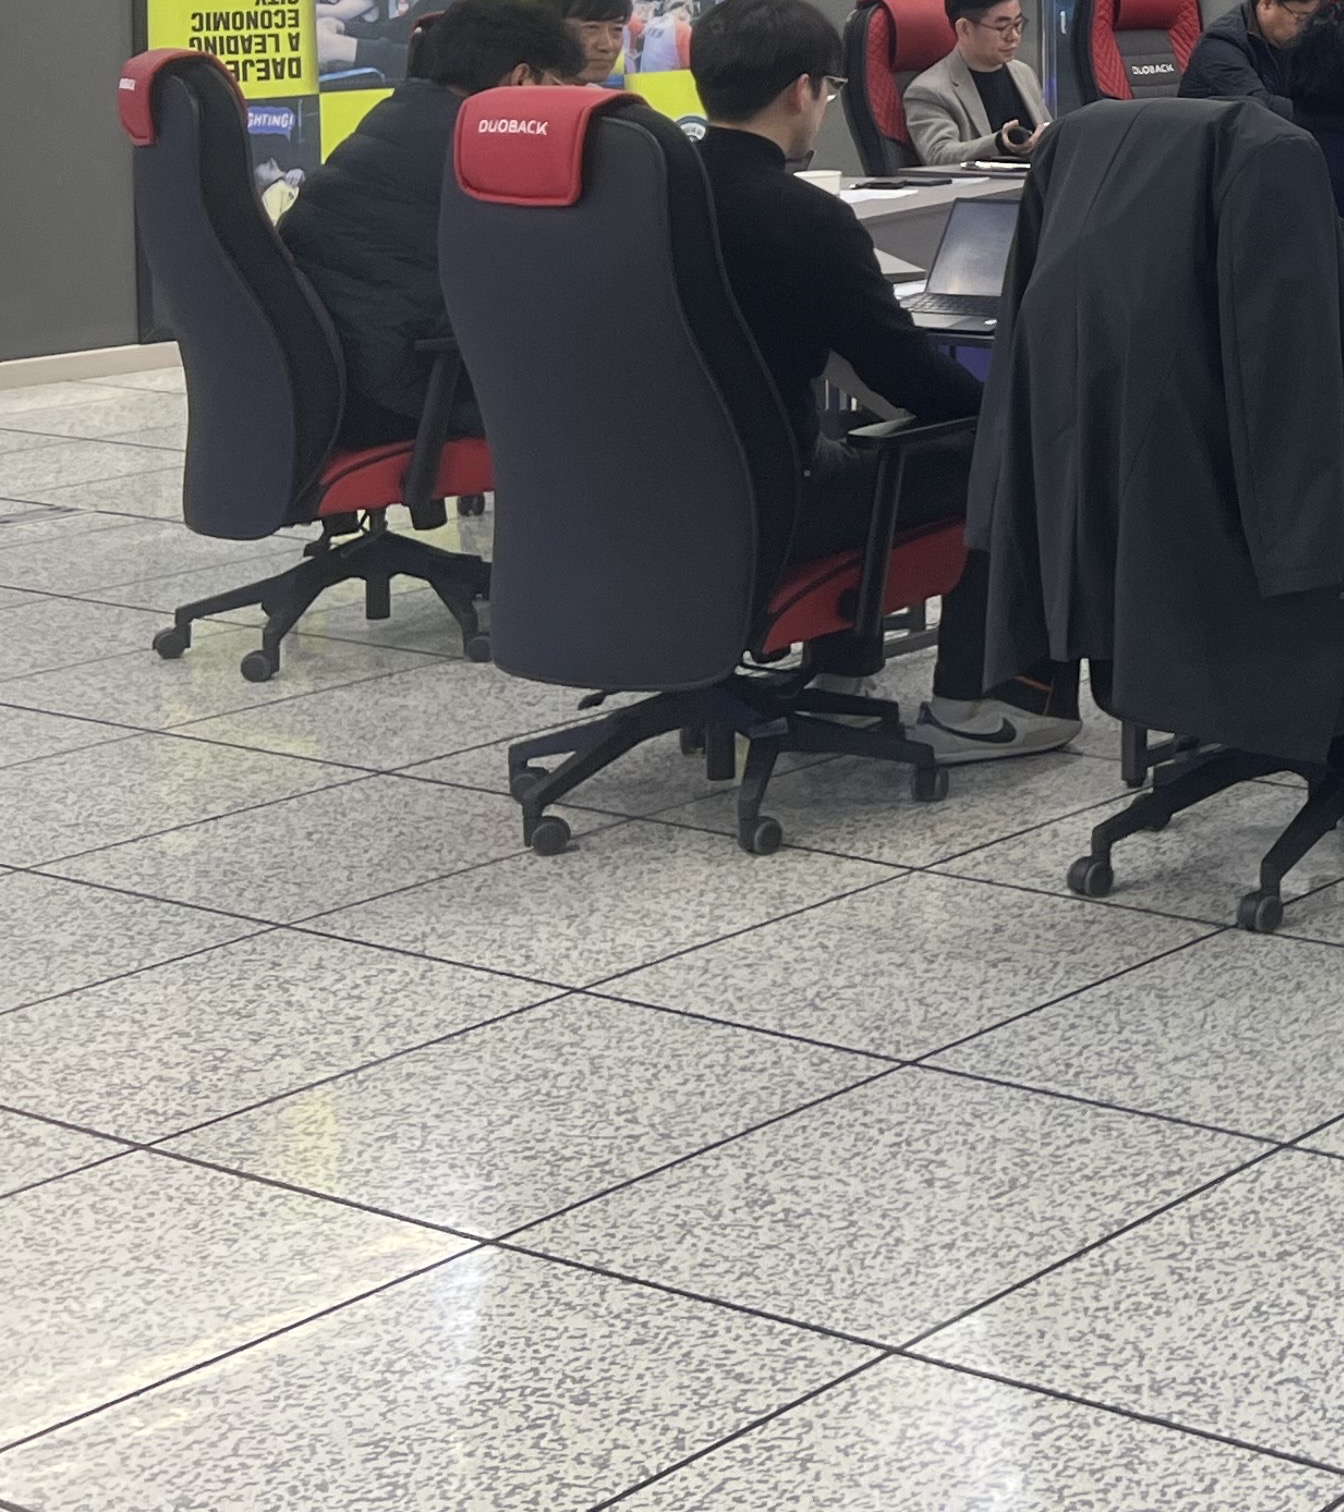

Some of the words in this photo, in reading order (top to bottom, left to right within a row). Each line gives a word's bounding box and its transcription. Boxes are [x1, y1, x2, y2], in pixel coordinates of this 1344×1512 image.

[190, 9, 299, 32] ECONOMIC
[189, 33, 280, 56] LEADING
[287, 32, 300, 52] A
[226, 56, 302, 82] DAEJE
[248, 112, 294, 130] GHTING!
[478, 119, 547, 136] DUOBACK
